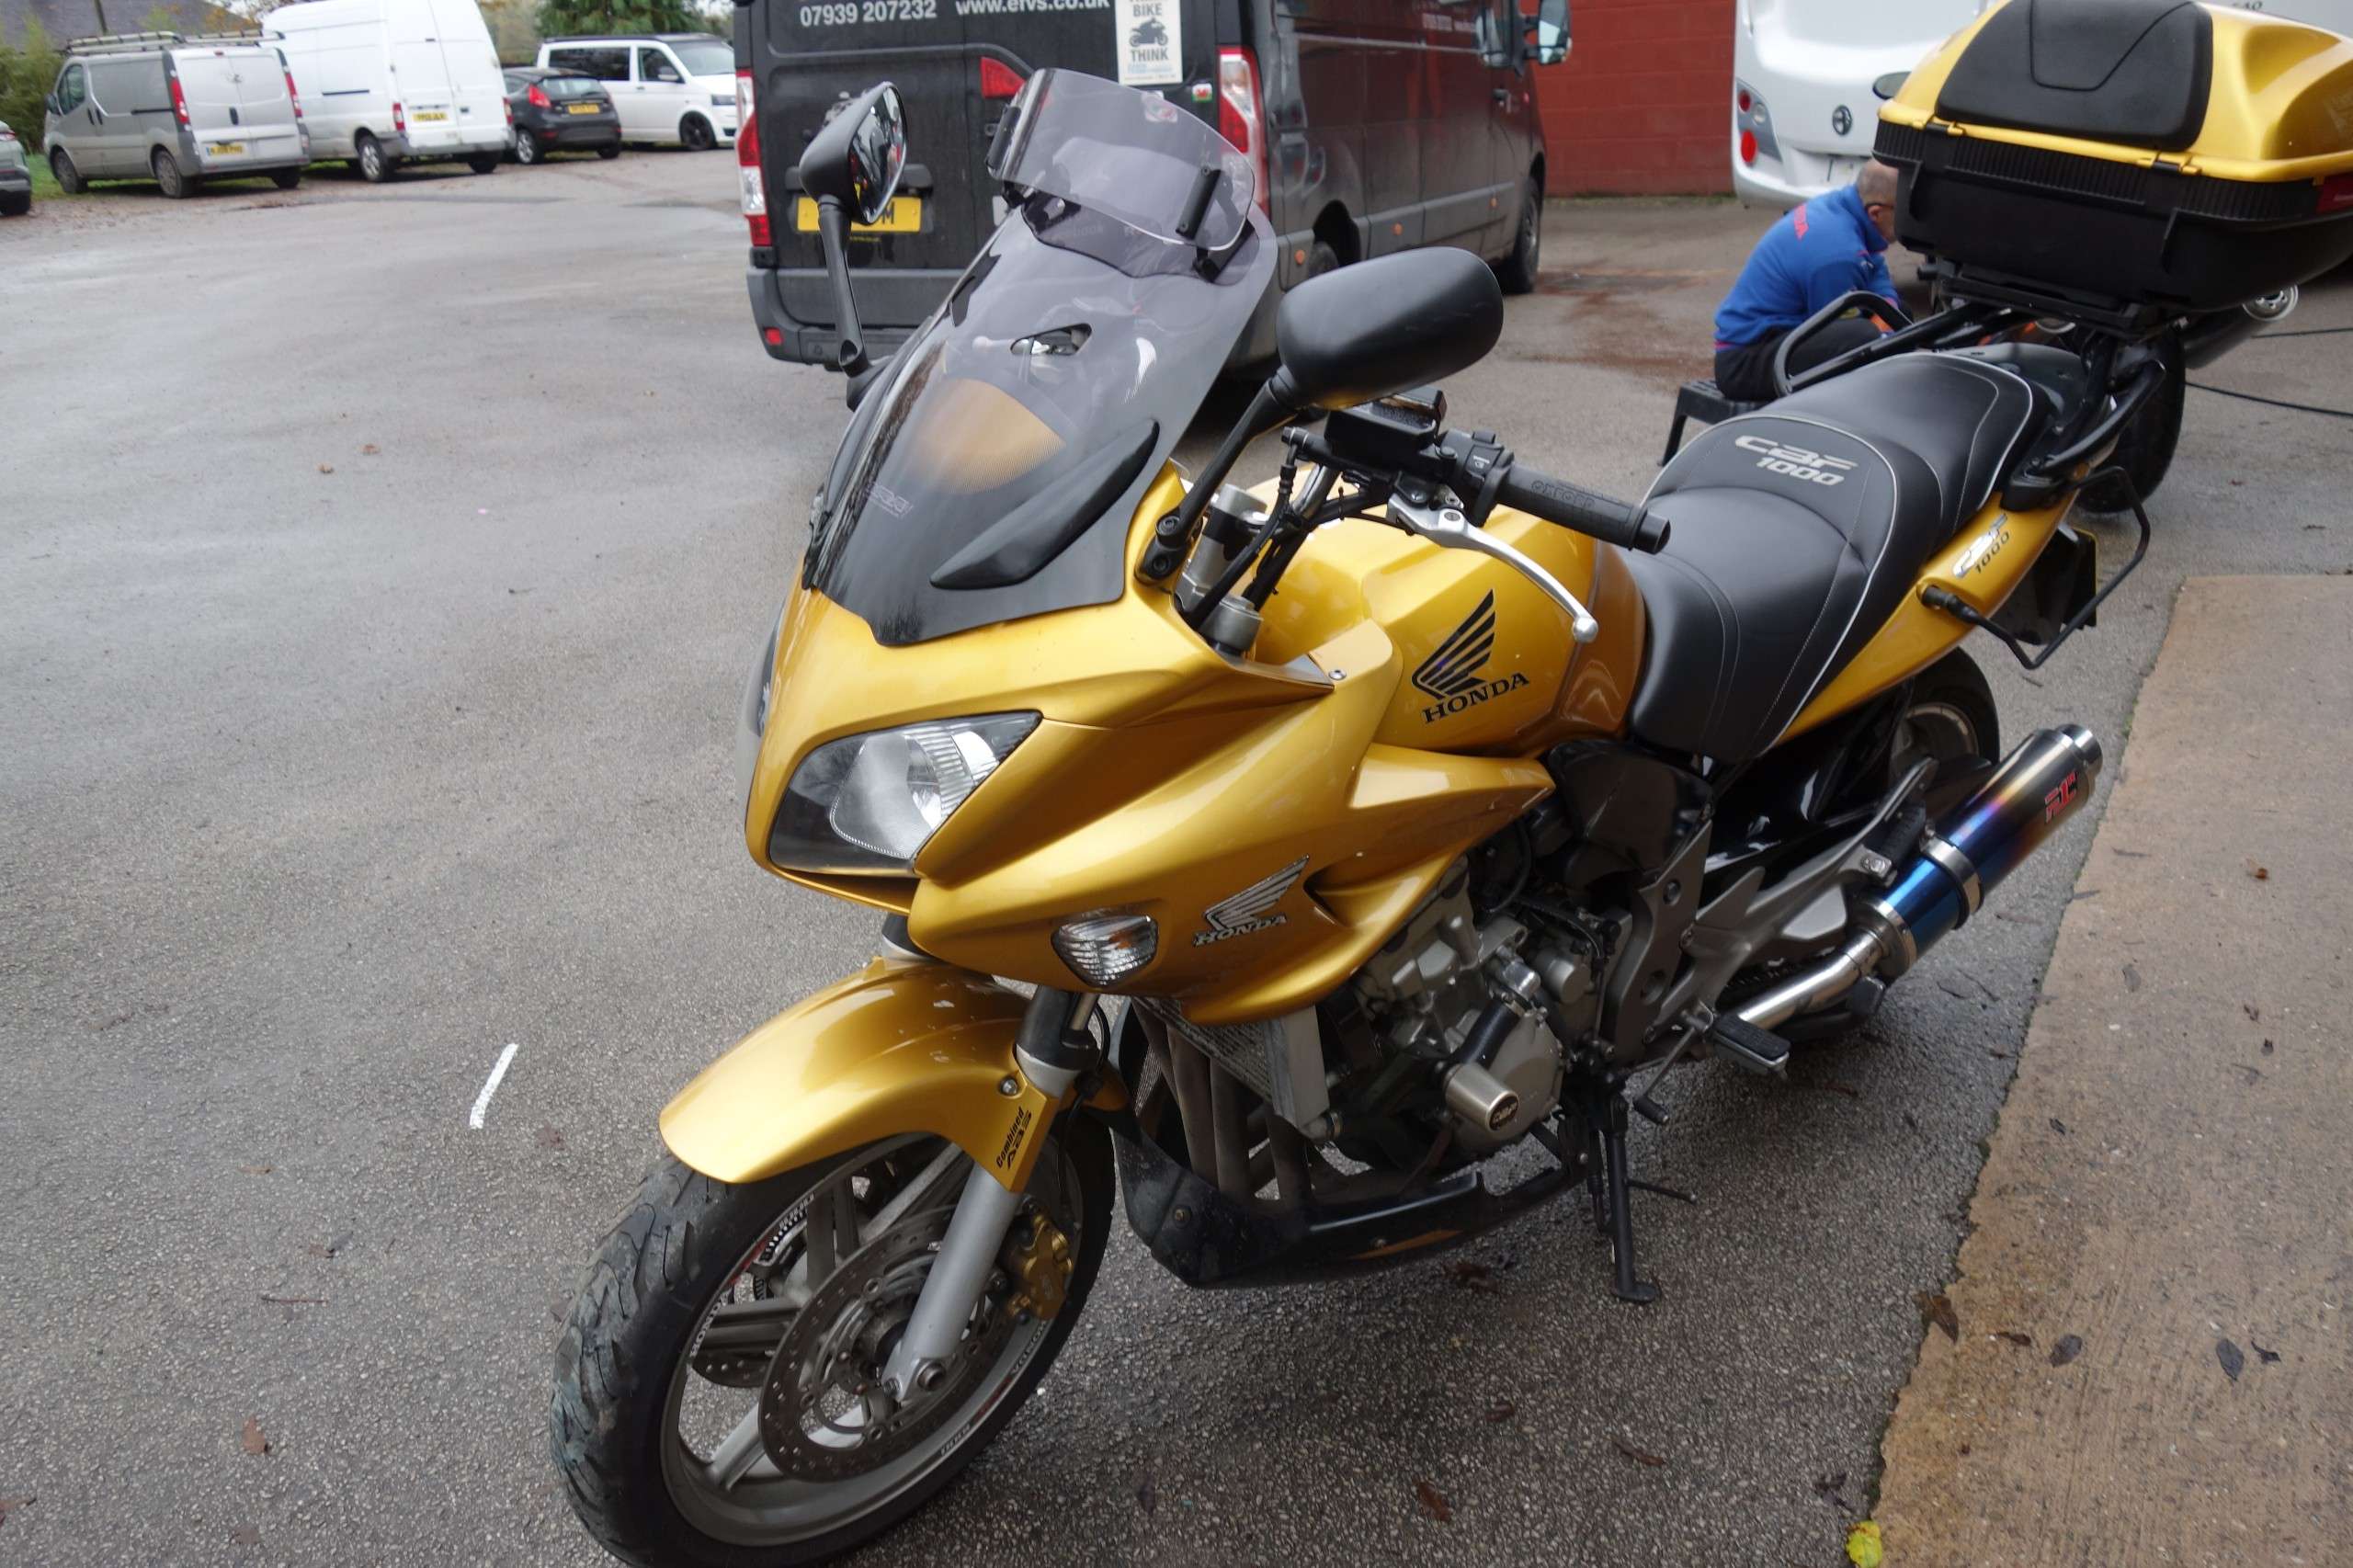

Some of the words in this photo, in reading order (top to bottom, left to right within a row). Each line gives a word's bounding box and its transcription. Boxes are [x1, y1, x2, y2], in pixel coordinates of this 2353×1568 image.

[800, 3, 858, 27] 07939
[863, 0, 938, 22] 207232
[1132, 3, 1163, 17] BIKE
[1131, 47, 1169, 62] THINK
[1734, 435, 1859, 471] CBF
[1756, 457, 1846, 486] 1000
[1975, 531, 2010, 574] 1000
[1422, 672, 1530, 723] HONDA
[1193, 913, 1287, 948] HONDA
[995, 1106, 1025, 1169] Combined
[1006, 1109, 1032, 1171] ABS
